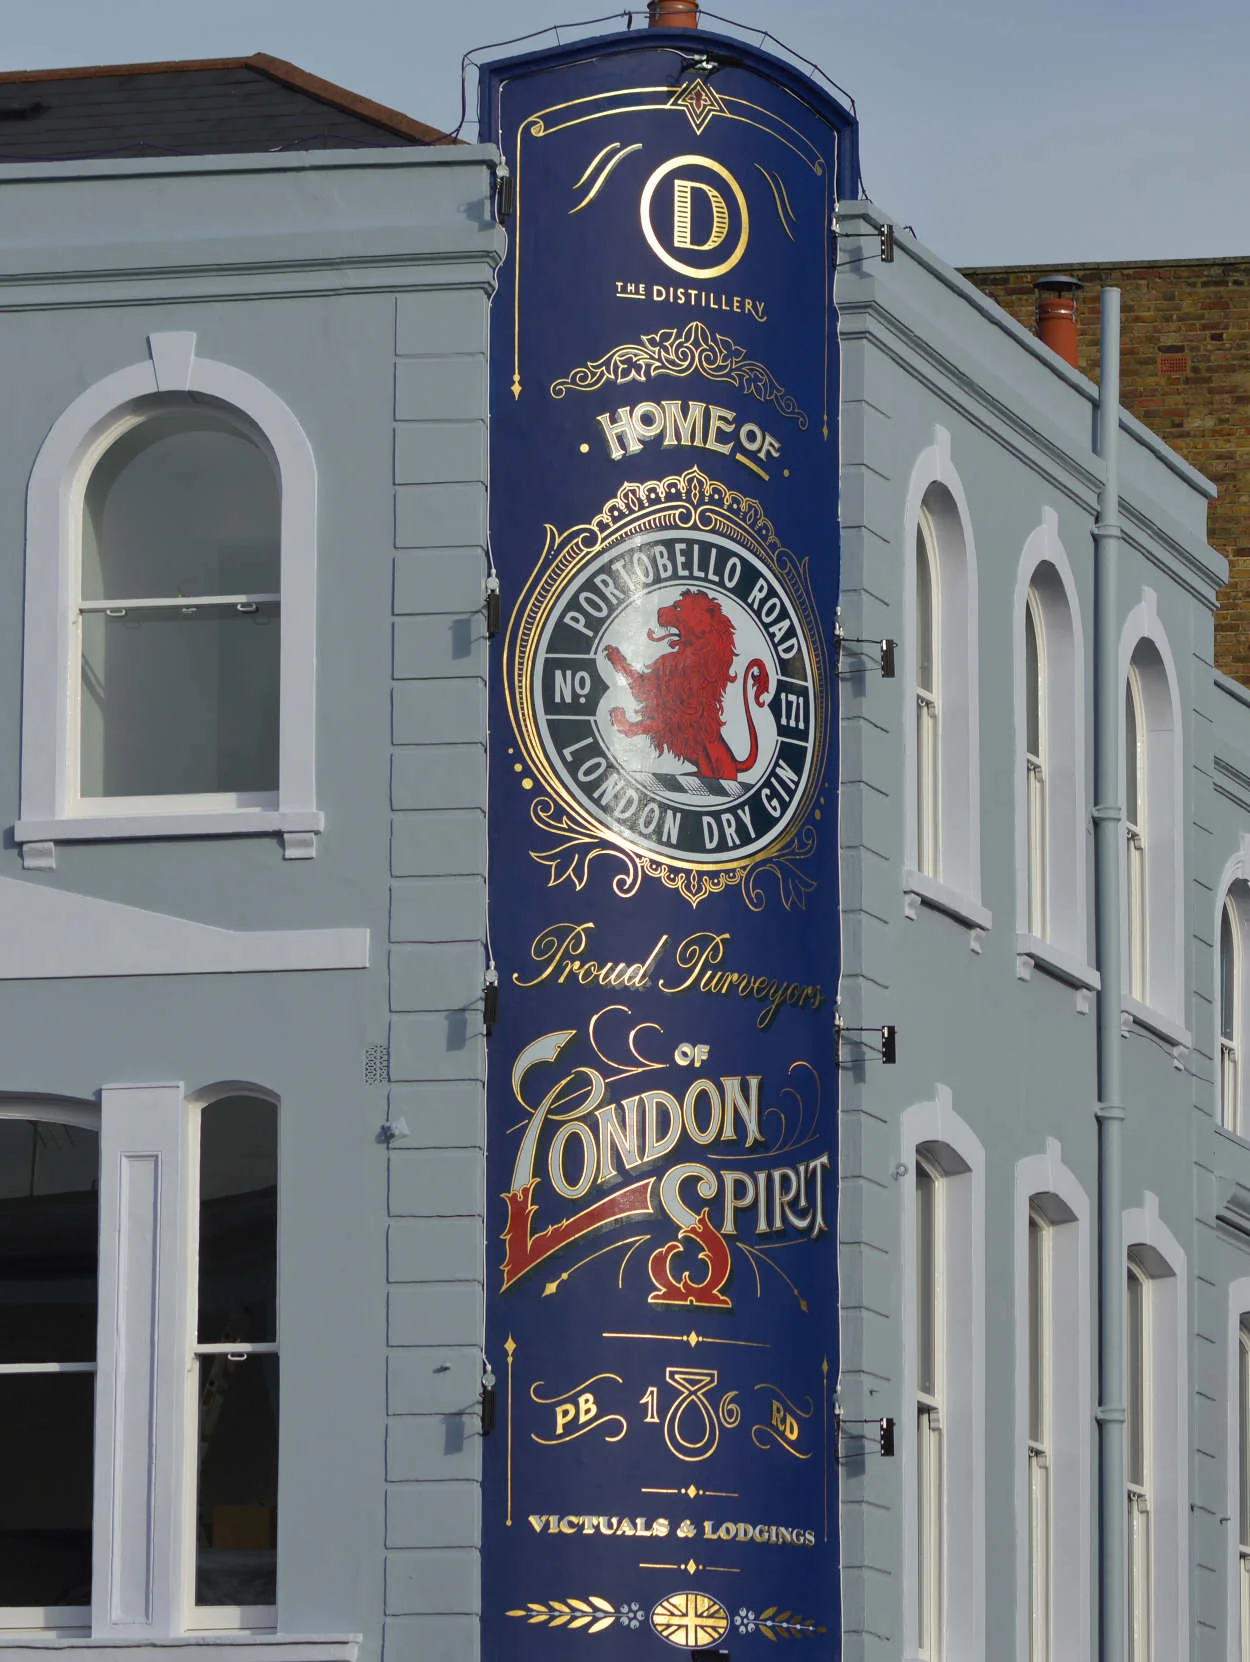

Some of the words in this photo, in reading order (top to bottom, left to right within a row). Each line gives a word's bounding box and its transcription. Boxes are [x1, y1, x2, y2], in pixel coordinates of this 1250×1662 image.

[674, 180, 729, 251] D
[615, 281, 647, 295] THE
[653, 285, 767, 321] DISTILLERY
[597, 400, 738, 460] HOME
[738, 422, 782, 462] OF
[563, 543, 742, 637] PORTOBELLO
[747, 578, 799, 662] ROAD
[780, 691, 805, 730] 171
[562, 737, 682, 846] LONDON
[703, 805, 757, 850] DRY
[761, 757, 799, 818] GIN
[513, 922, 669, 988] Proud
[659, 932, 826, 1029] Purveyors
[674, 1042, 710, 1068] OF
[500, 1030, 766, 1294] LONDON
[648, 1152, 831, 1308] SPIRIT
[555, 1392, 599, 1435] PB
[639, 1367, 742, 1461] 186
[771, 1399, 800, 1441] RD
[528, 1514, 670, 1538] VICTUALS
[676, 1518, 697, 1539] &
[703, 1519, 816, 1547] LODGINGS
